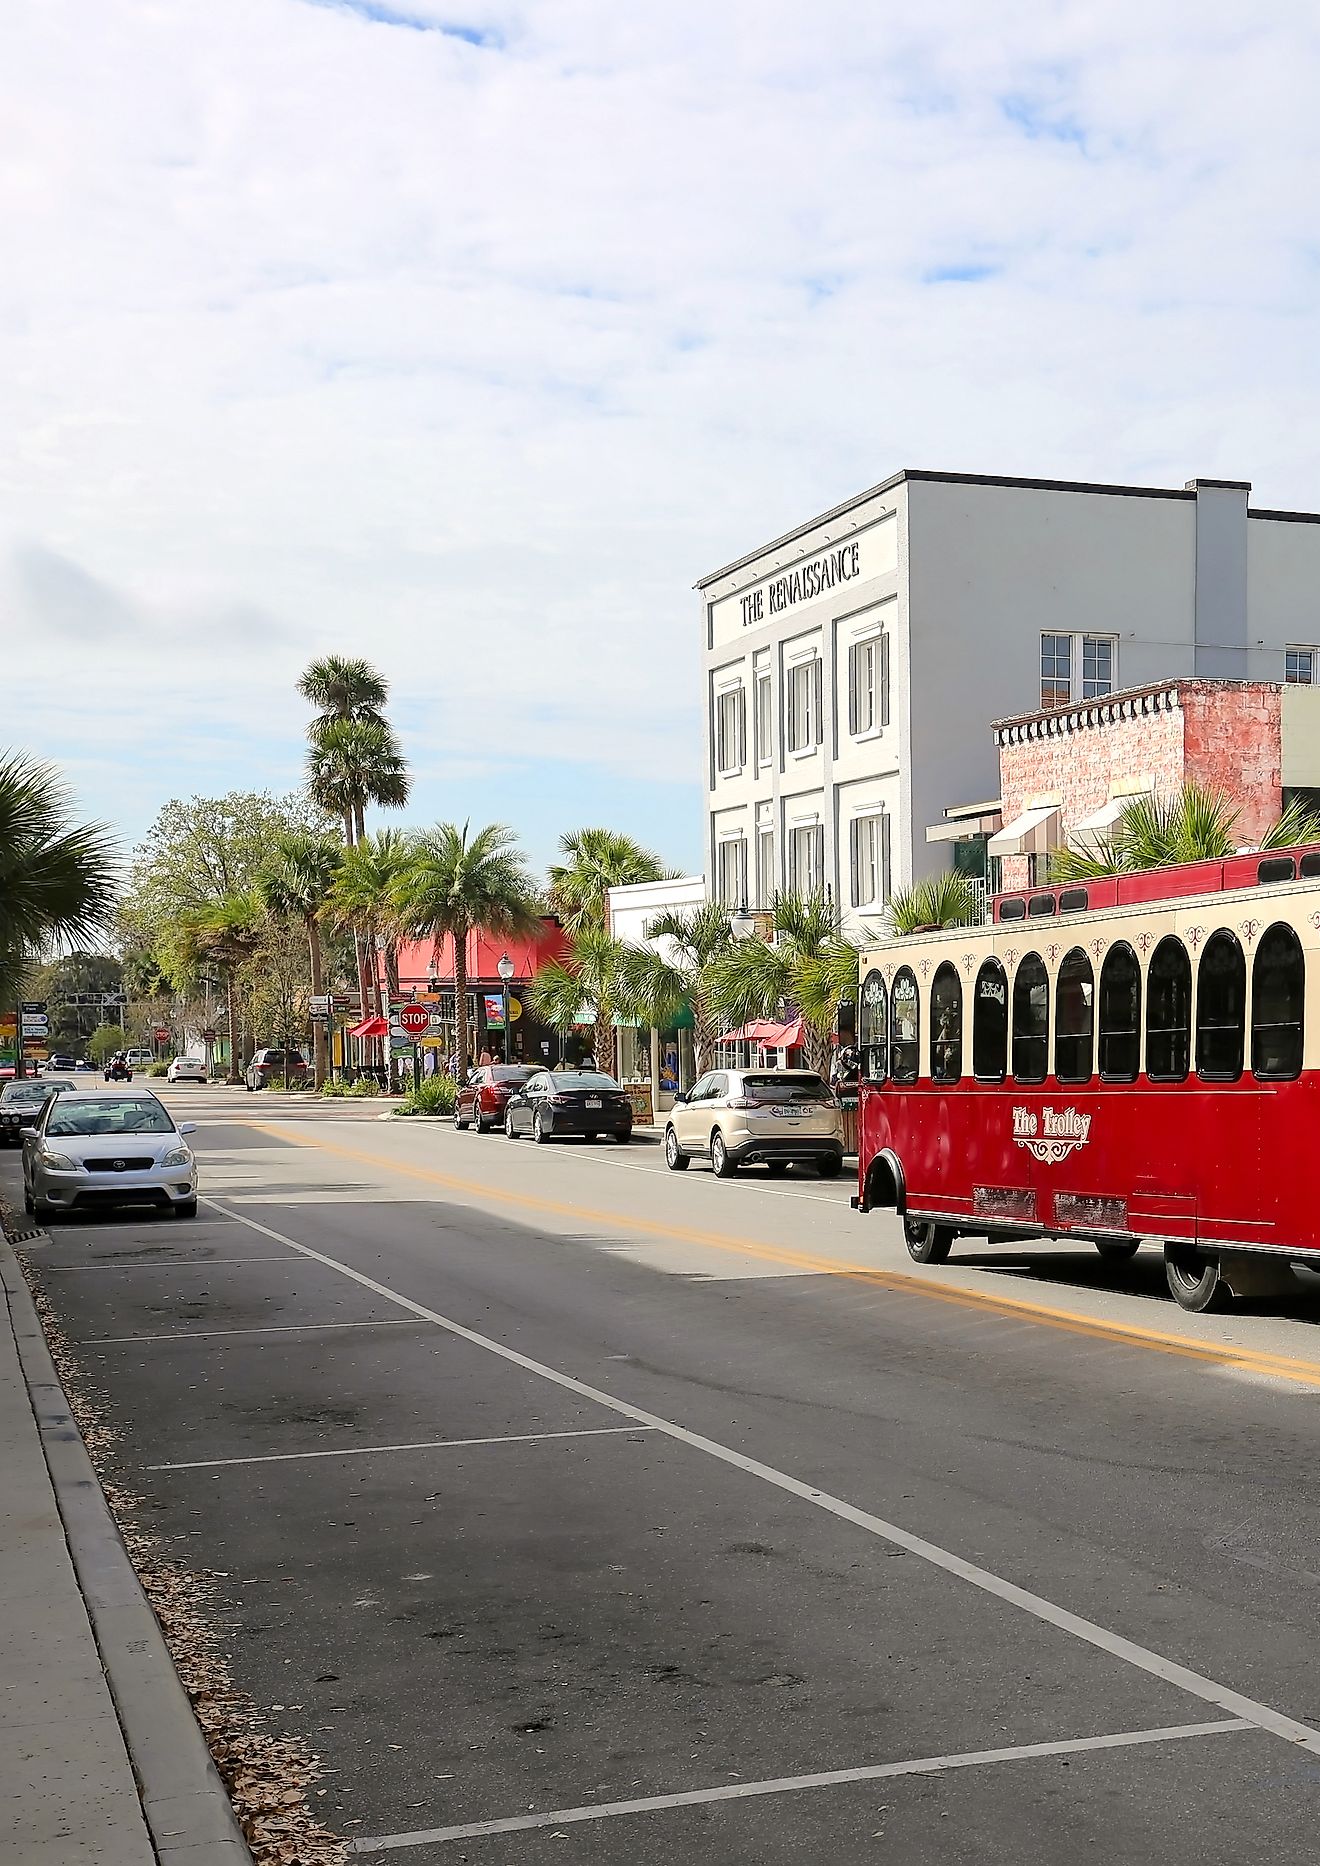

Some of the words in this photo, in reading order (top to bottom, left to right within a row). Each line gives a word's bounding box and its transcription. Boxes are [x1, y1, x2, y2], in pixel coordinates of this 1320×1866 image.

[740, 589, 763, 626] THE
[769, 542, 860, 615] RENAISSANCE
[401, 1013, 428, 1025] STOP
[1012, 1106, 1038, 1136] The
[1042, 1106, 1092, 1143] Trolley
